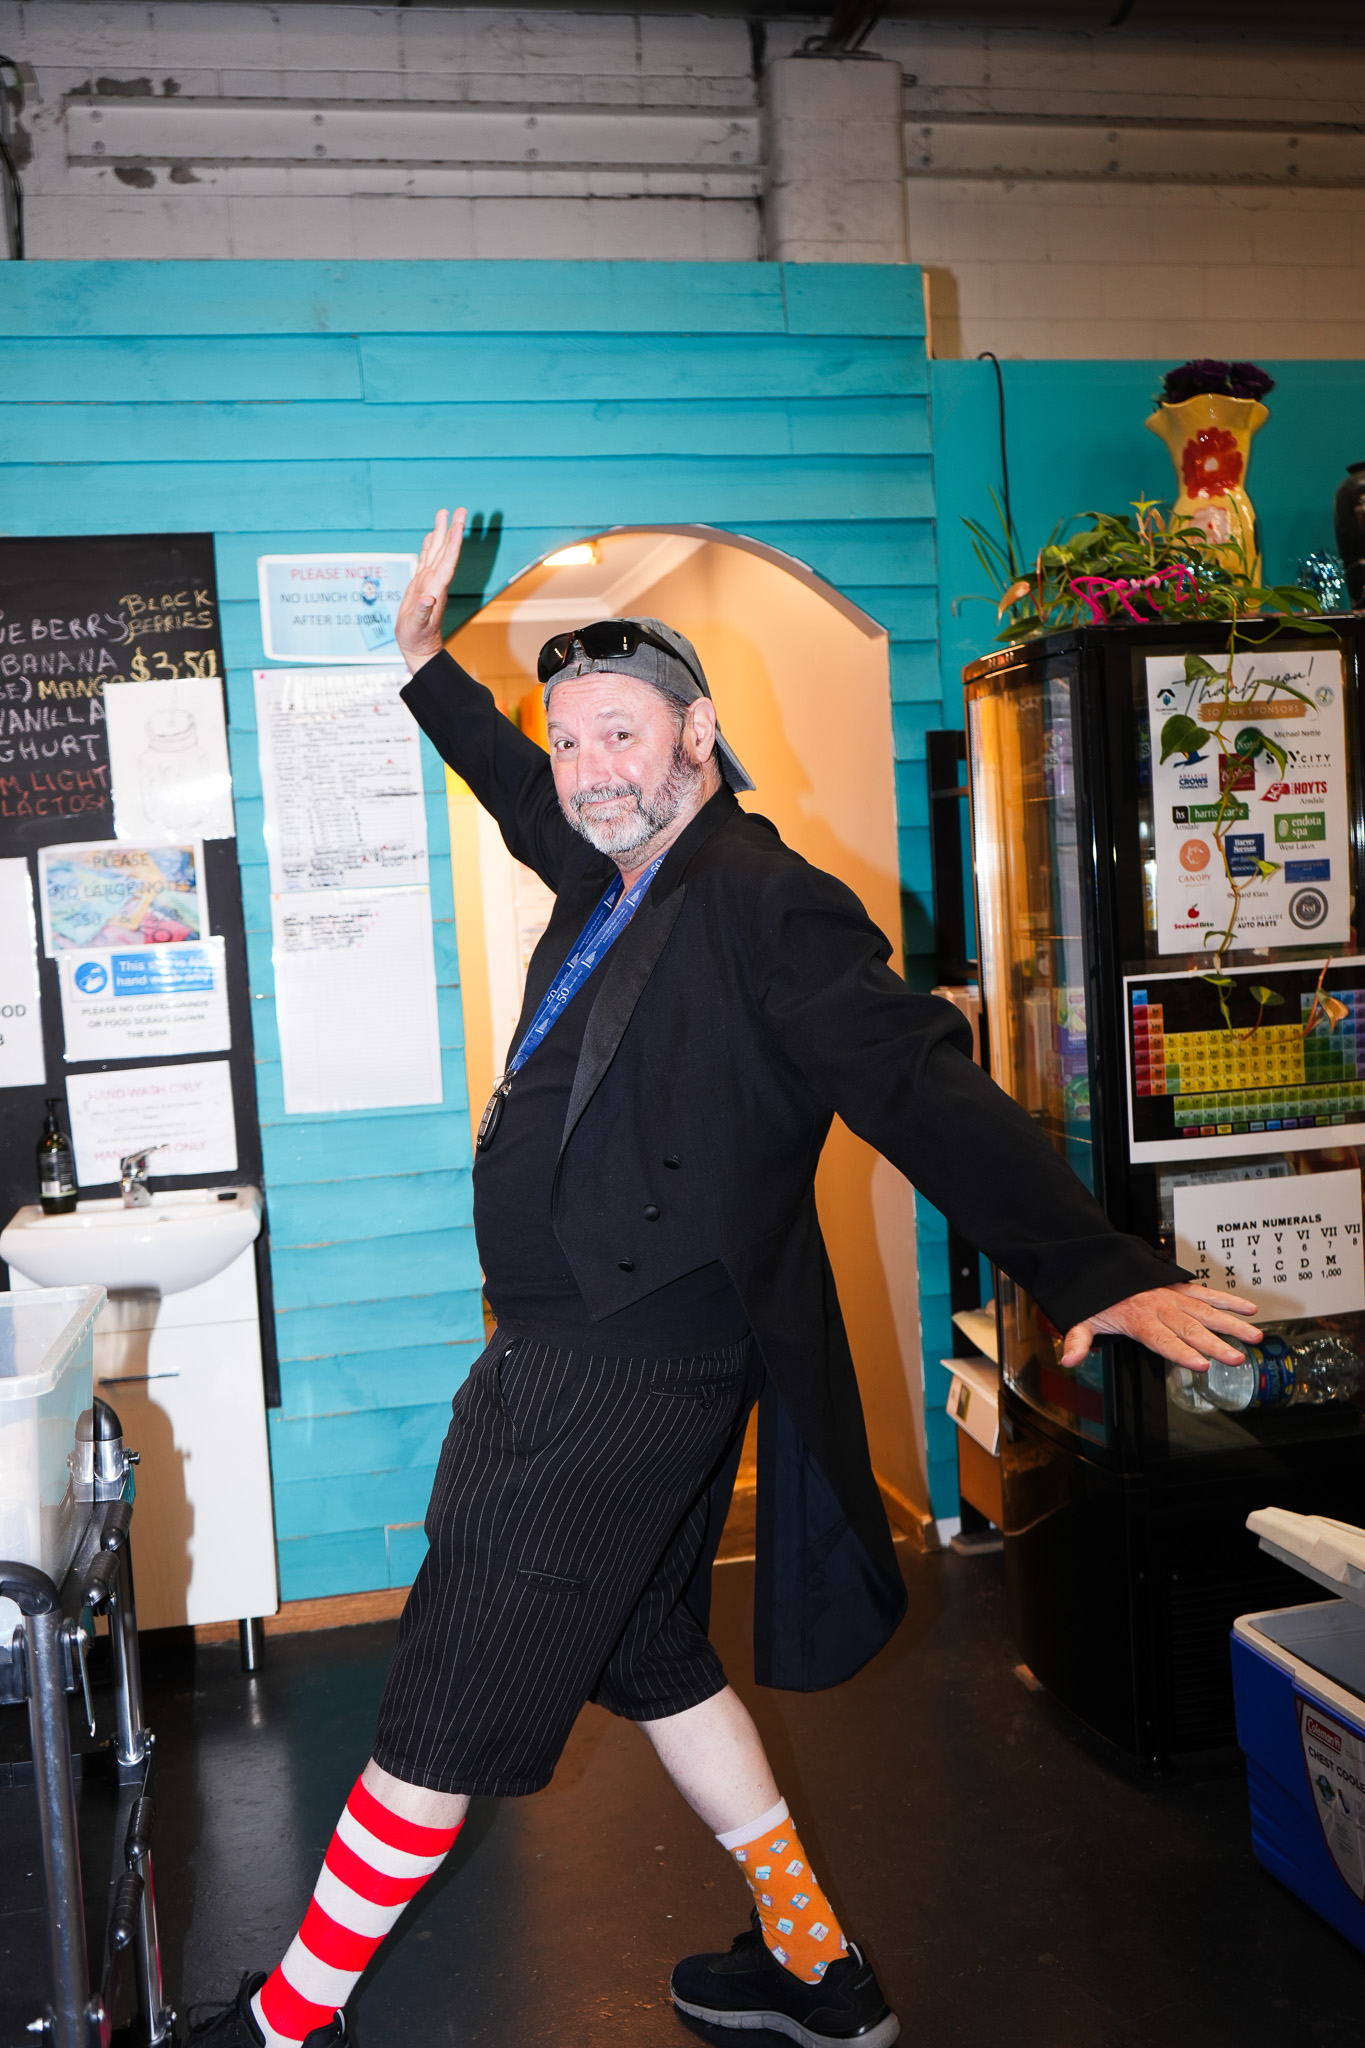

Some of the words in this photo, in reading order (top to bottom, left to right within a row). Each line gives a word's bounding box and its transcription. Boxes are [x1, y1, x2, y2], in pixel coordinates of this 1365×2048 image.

[290, 567, 341, 581] PLEASE
[119, 589, 214, 617] BLACK
[280, 593, 300, 604] NO
[306, 592, 347, 604] LUNCH
[293, 615, 333, 626] AFTER
[123, 610, 214, 645] BERRIES
[0, 648, 118, 677] BANANA
[1266, 656, 1314, 704] you!
[1207, 708, 1220, 718] TO
[1248, 704, 1300, 716] SPONSORS
[1274, 729, 1300, 738] Michael
[1301, 728, 1321, 737] Nettle
[1300, 753, 1331, 763] CITY
[30, 764, 108, 792] LIGHT
[1179, 777, 1208, 786] CROWS
[1293, 781, 1328, 795] HOYTS
[1300, 797, 1325, 805] Arndale
[1175, 809, 1185, 820] hs
[1194, 806, 1218, 819] harris
[1291, 815, 1322, 827] endota
[1291, 828, 1308, 839] spa
[1296, 842, 1315, 851] Lakes
[1178, 875, 1213, 884] CANOPY
[1302, 903, 1316, 913] Fed
[1257, 920, 1277, 928] PARTS
[118, 960, 146, 972] This
[116, 975, 147, 987] hand
[556, 987, 570, 1004] 50
[1216, 1221, 1257, 1233] ROMAN
[1262, 1213, 1322, 1228] NUMERALS
[1196, 1241, 1206, 1251] II
[1221, 1238, 1234, 1249] III
[1247, 1235, 1260, 1246] IV
[1274, 1232, 1283, 1243] V
[1297, 1230, 1310, 1240] VI
[1320, 1226, 1337, 1238] VII
[1200, 1253, 1205, 1263] 2
[1226, 1251, 1231, 1260] 3
[1251, 1248, 1256, 1257] 4
[1276, 1246, 1282, 1255] 5
[1302, 1243, 1307, 1252] 6
[1327, 1240, 1332, 1249] 7
[1352, 1237, 1357, 1246] 8
[1195, 1268, 1210, 1280] IX
[1225, 1266, 1235, 1277] X
[1252, 1263, 1260, 1274] L
[1275, 1260, 1284, 1271] C
[1300, 1258, 1310, 1269] D
[1325, 1255, 1337, 1265] M
[1226, 1279, 1236, 1289] 10
[1252, 1276, 1261, 1286] 50
[1273, 1274, 1287, 1284] 100
[1298, 1271, 1312, 1281] 500
[1321, 1267, 1342, 1279] 1,000
[1307, 1718, 1334, 1746] Coleman
[1308, 1746, 1335, 1773] CHEST
